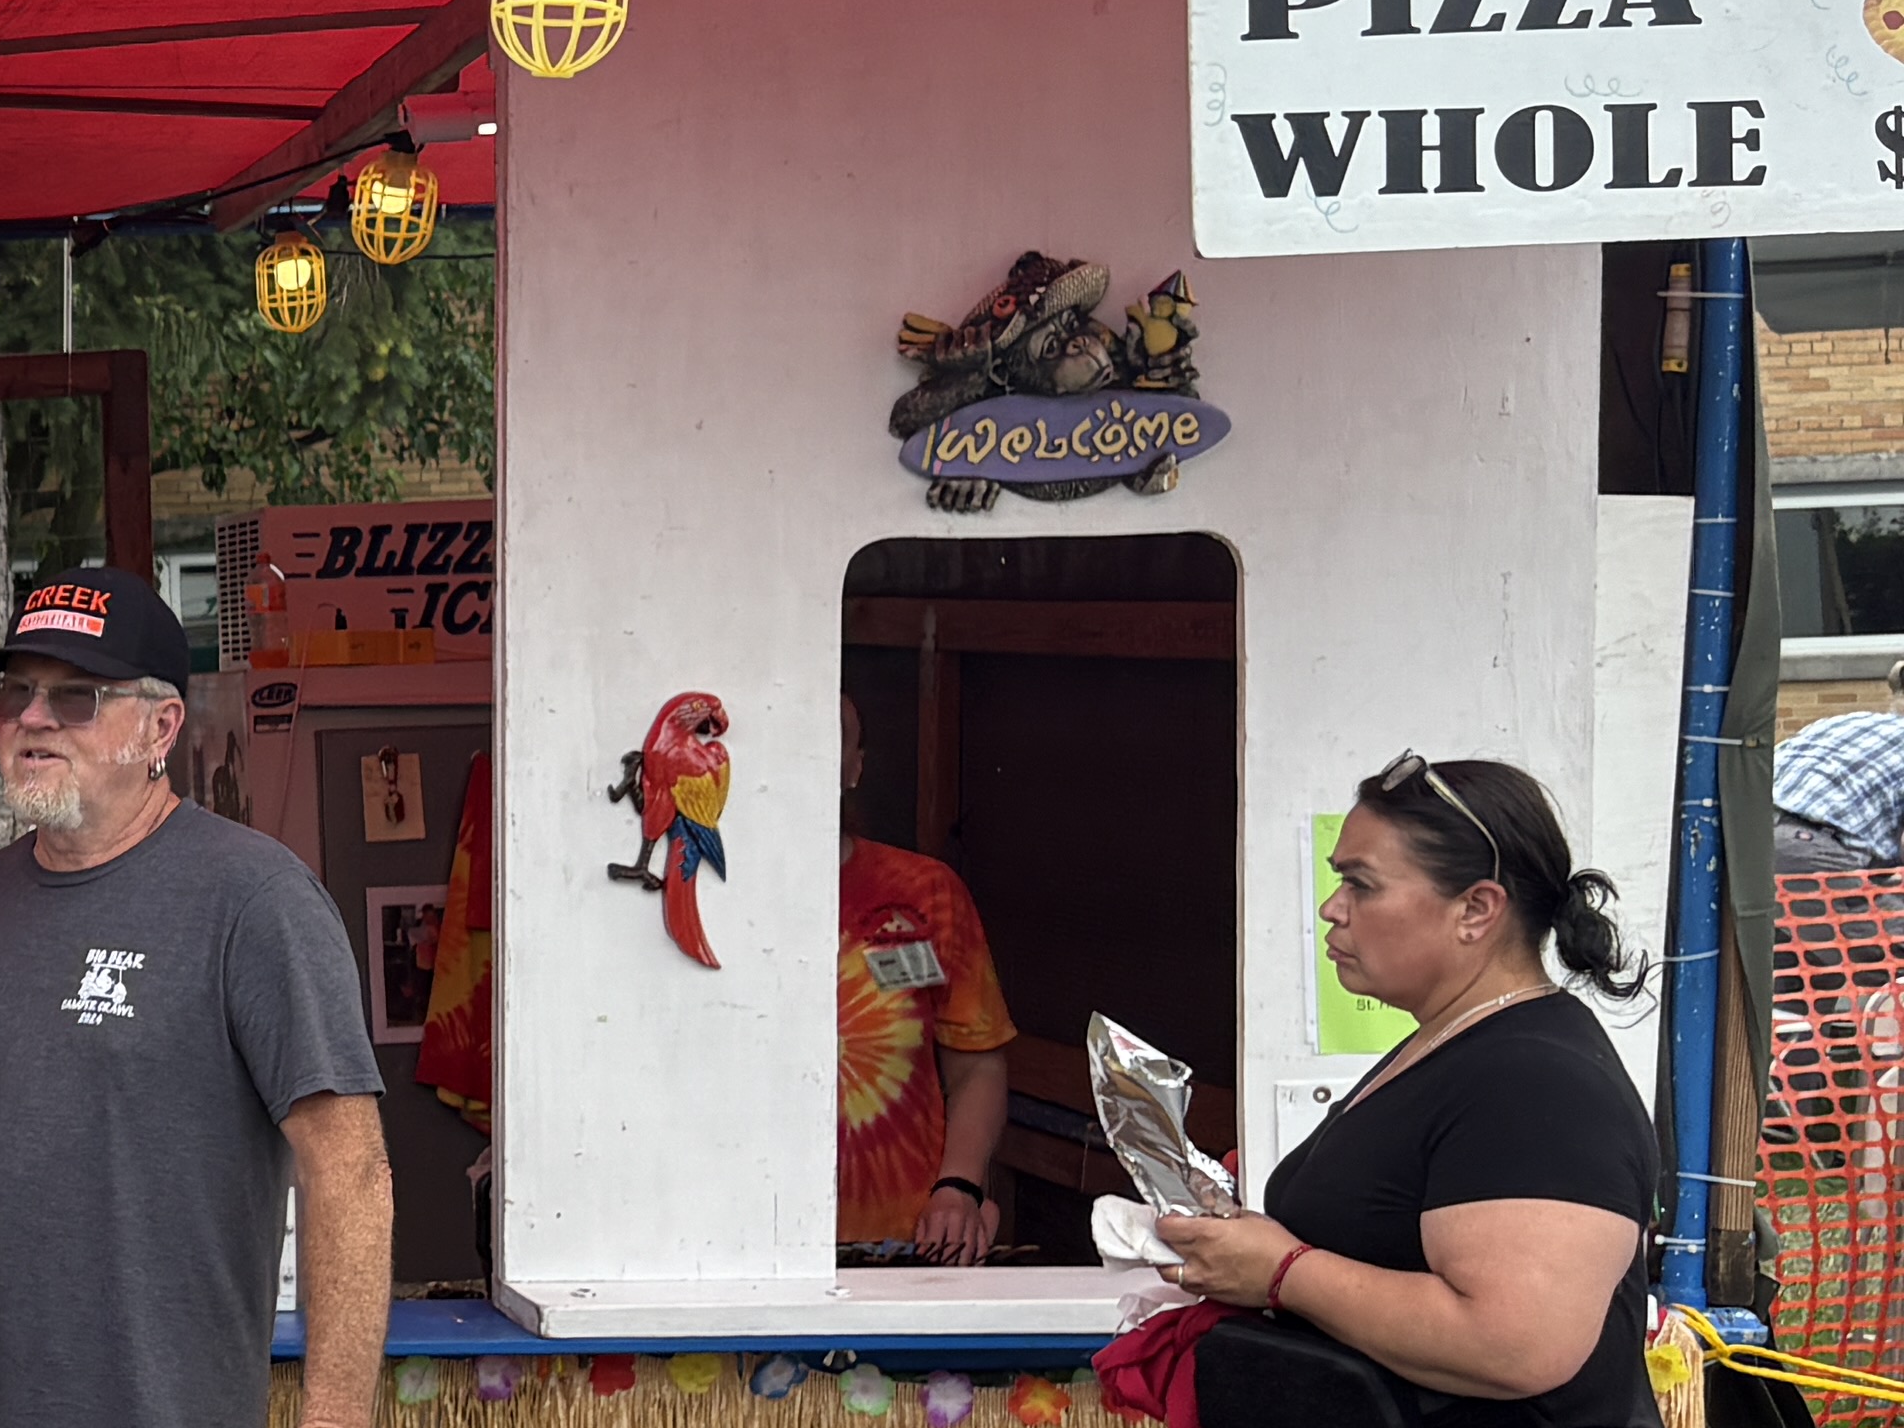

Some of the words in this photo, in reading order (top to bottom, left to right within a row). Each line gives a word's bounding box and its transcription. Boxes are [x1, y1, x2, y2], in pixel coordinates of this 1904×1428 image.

[1230, 98, 1768, 200] WHOLE
[24, 584, 112, 615] CREEK
[107, 950, 146, 969] BEAR
[97, 1000, 135, 1018] CRAWL
